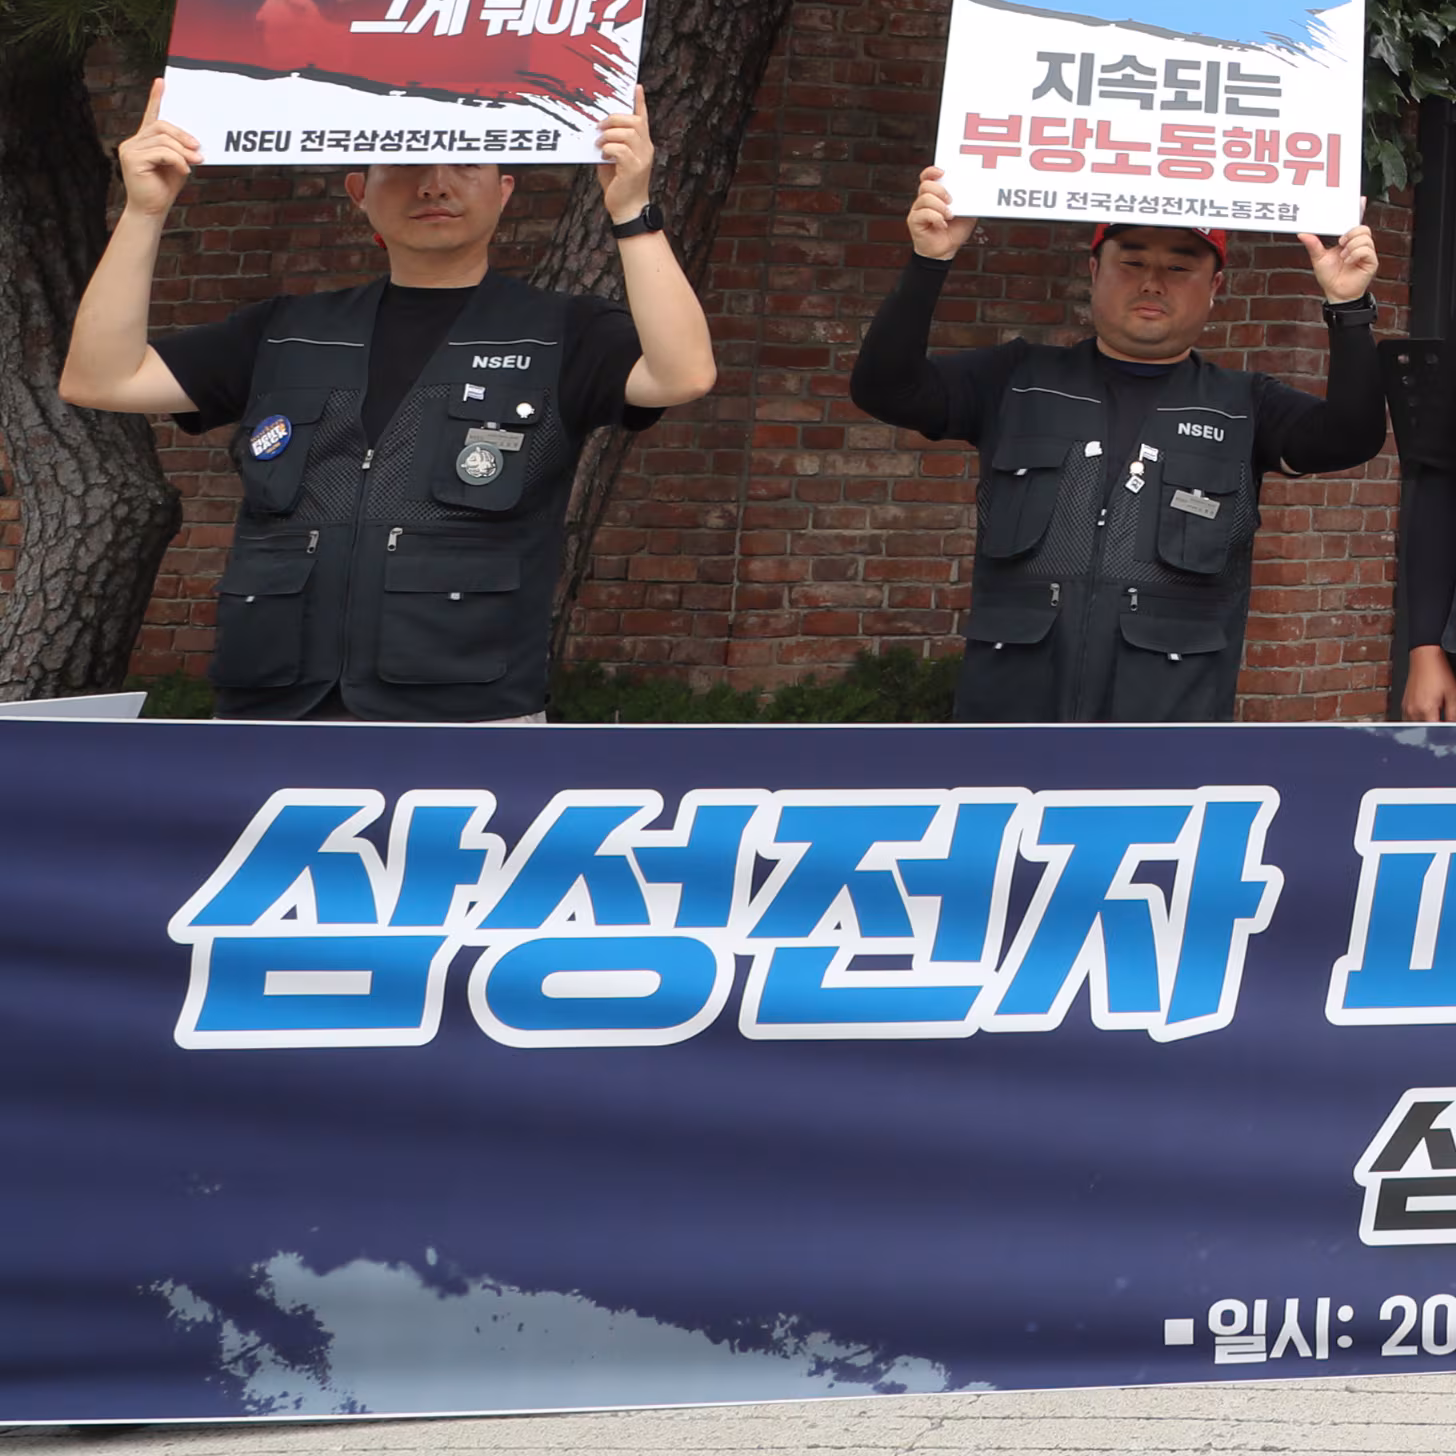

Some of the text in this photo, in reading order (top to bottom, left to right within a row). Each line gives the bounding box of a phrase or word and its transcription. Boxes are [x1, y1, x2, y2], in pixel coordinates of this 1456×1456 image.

[1032, 51, 1282, 118] 지속되는
[225, 129, 561, 153] NSEU 전국삼성전자노동조합
[959, 112, 1341, 188] 부당노동행위
[997, 188, 1300, 222] NSEU 전국삼성전자노동조합
[472, 355, 532, 370] NSEU
[1178, 422, 1225, 442] NSEU
[166, 785, 1283, 1049] 삼성전자
[1207, 1296, 1354, 1365] 일시:
